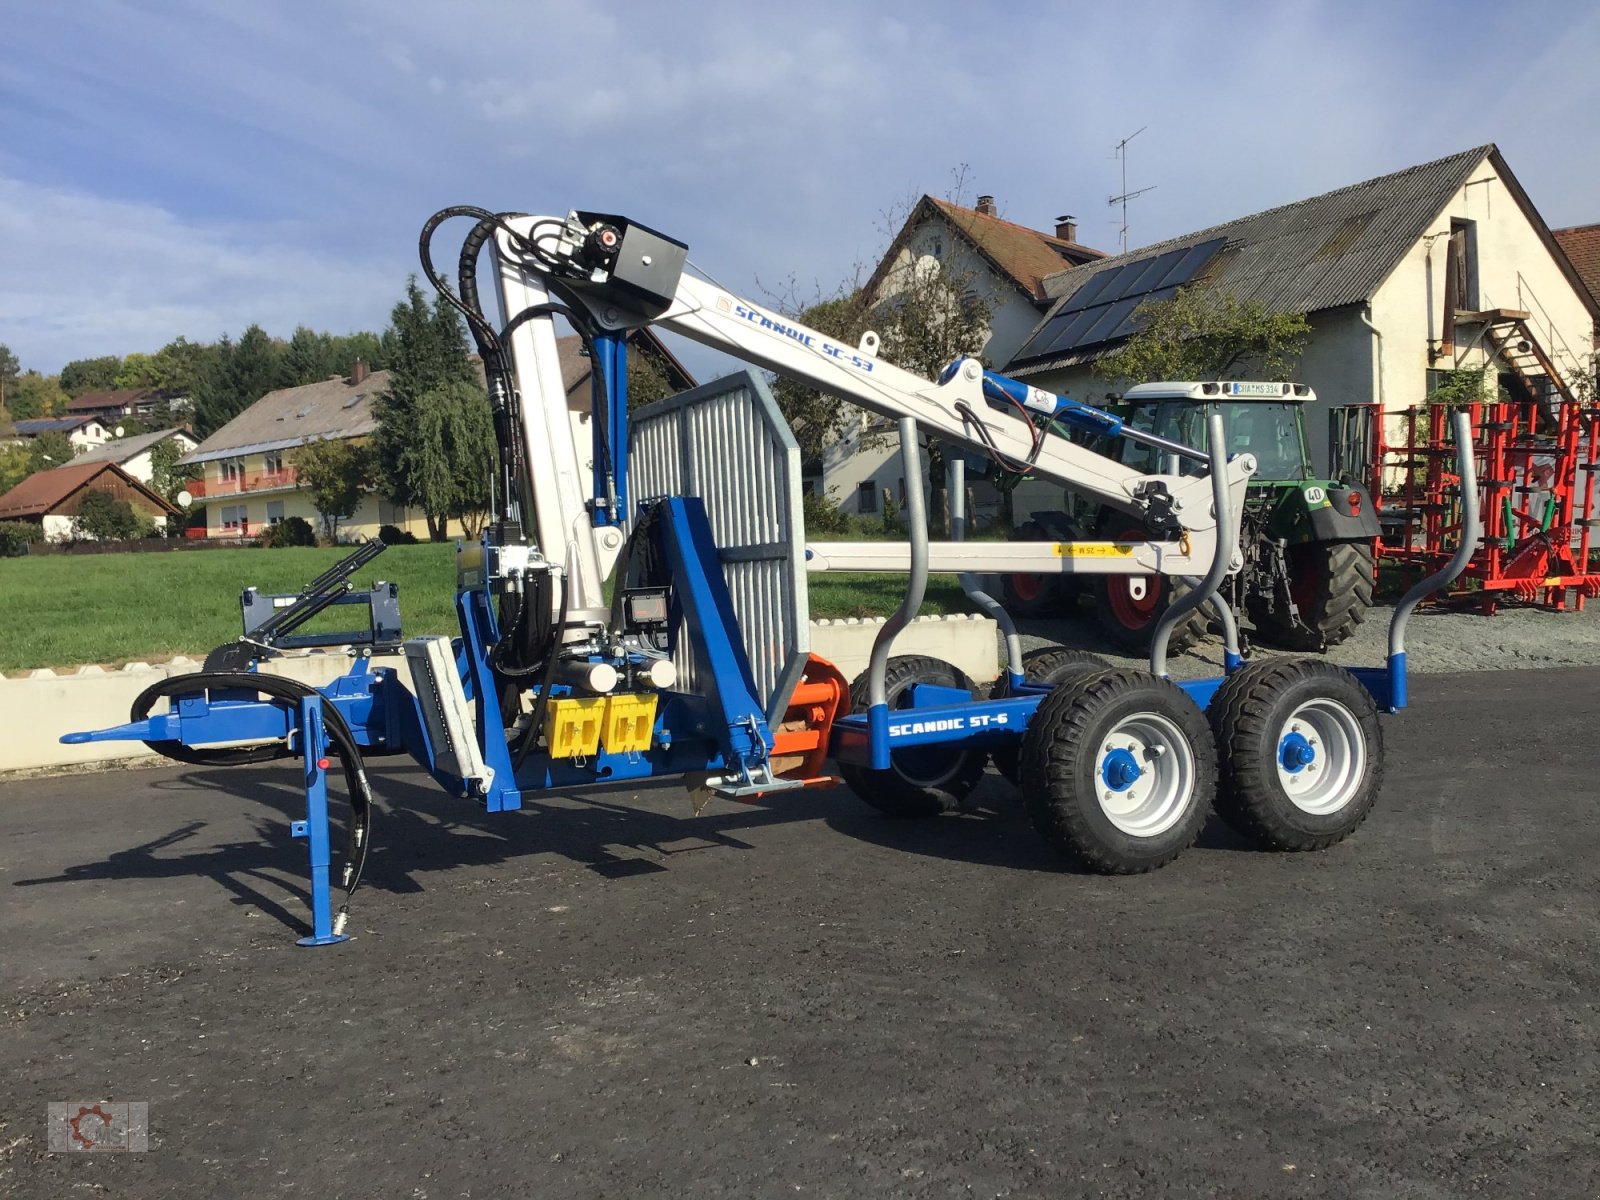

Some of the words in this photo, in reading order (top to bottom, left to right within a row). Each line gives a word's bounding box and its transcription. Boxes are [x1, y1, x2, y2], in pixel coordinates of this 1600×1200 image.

[735, 305, 816, 348] SCANDIC
[822, 342, 874, 372] SC-53
[1308, 489, 1322, 501] 40
[889, 718, 965, 737] SCANDIC
[969, 713, 1008, 728] ST-6
